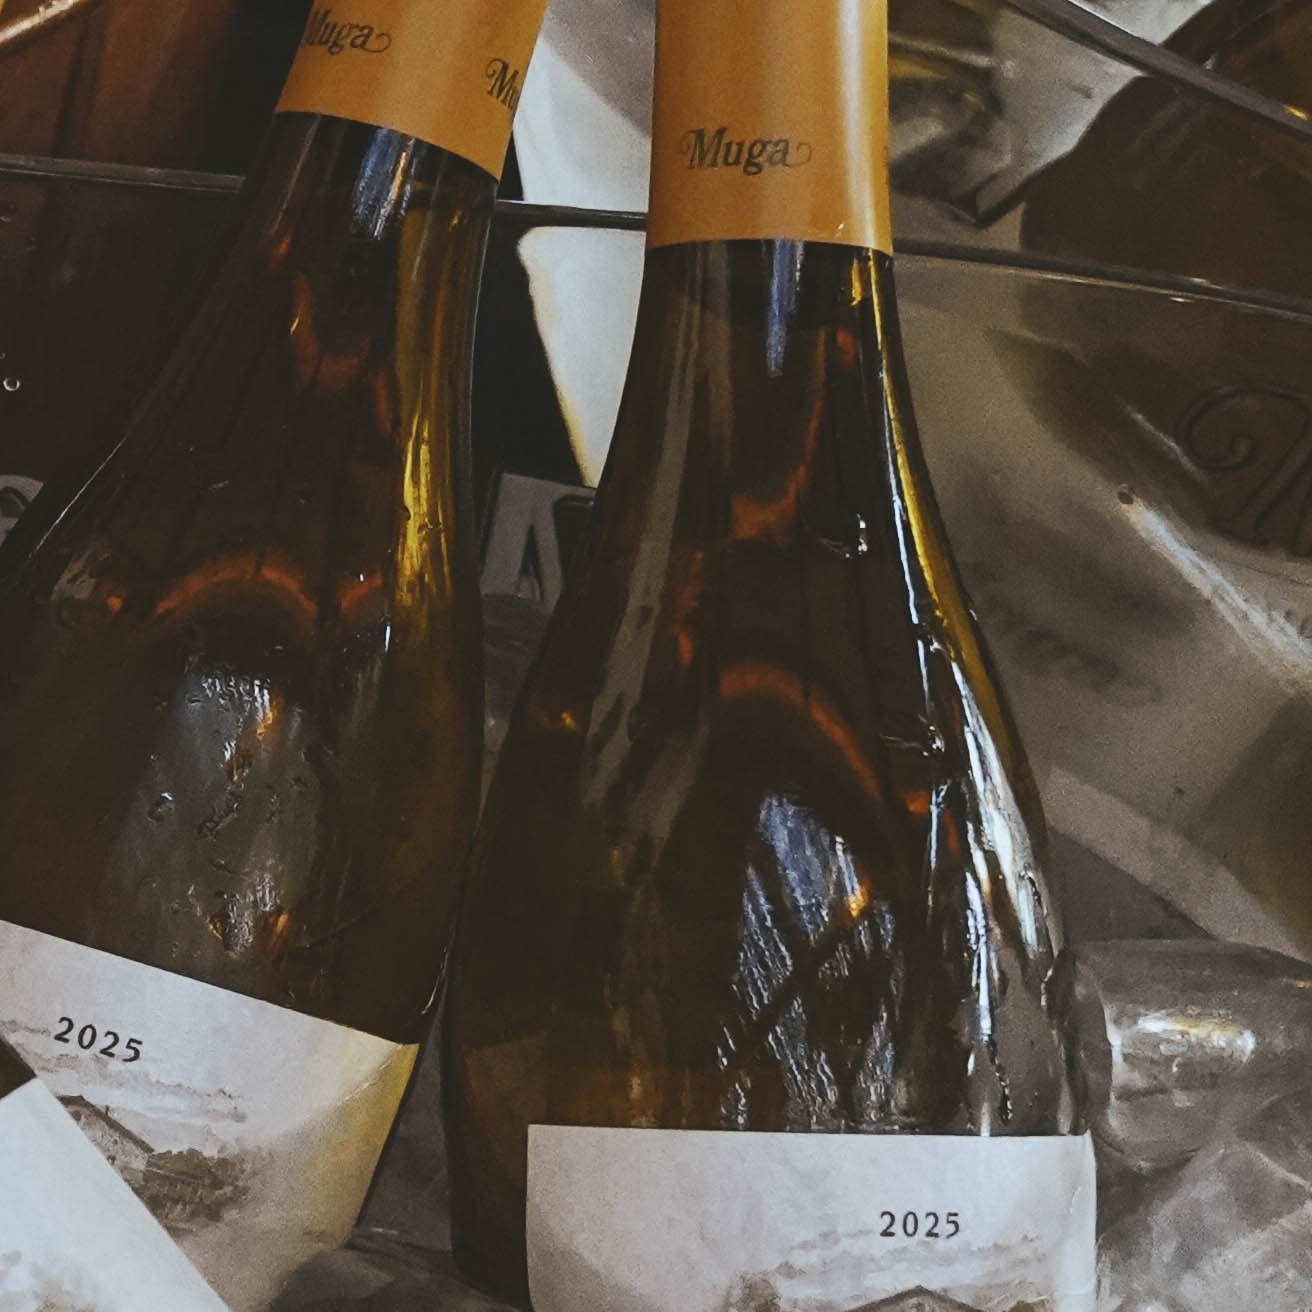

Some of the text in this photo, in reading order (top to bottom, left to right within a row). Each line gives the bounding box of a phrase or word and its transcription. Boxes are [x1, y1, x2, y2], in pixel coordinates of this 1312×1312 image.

[680, 127, 813, 176] Muga
[53, 1016, 143, 1063] 2025
[879, 1210, 960, 1239] 2025
